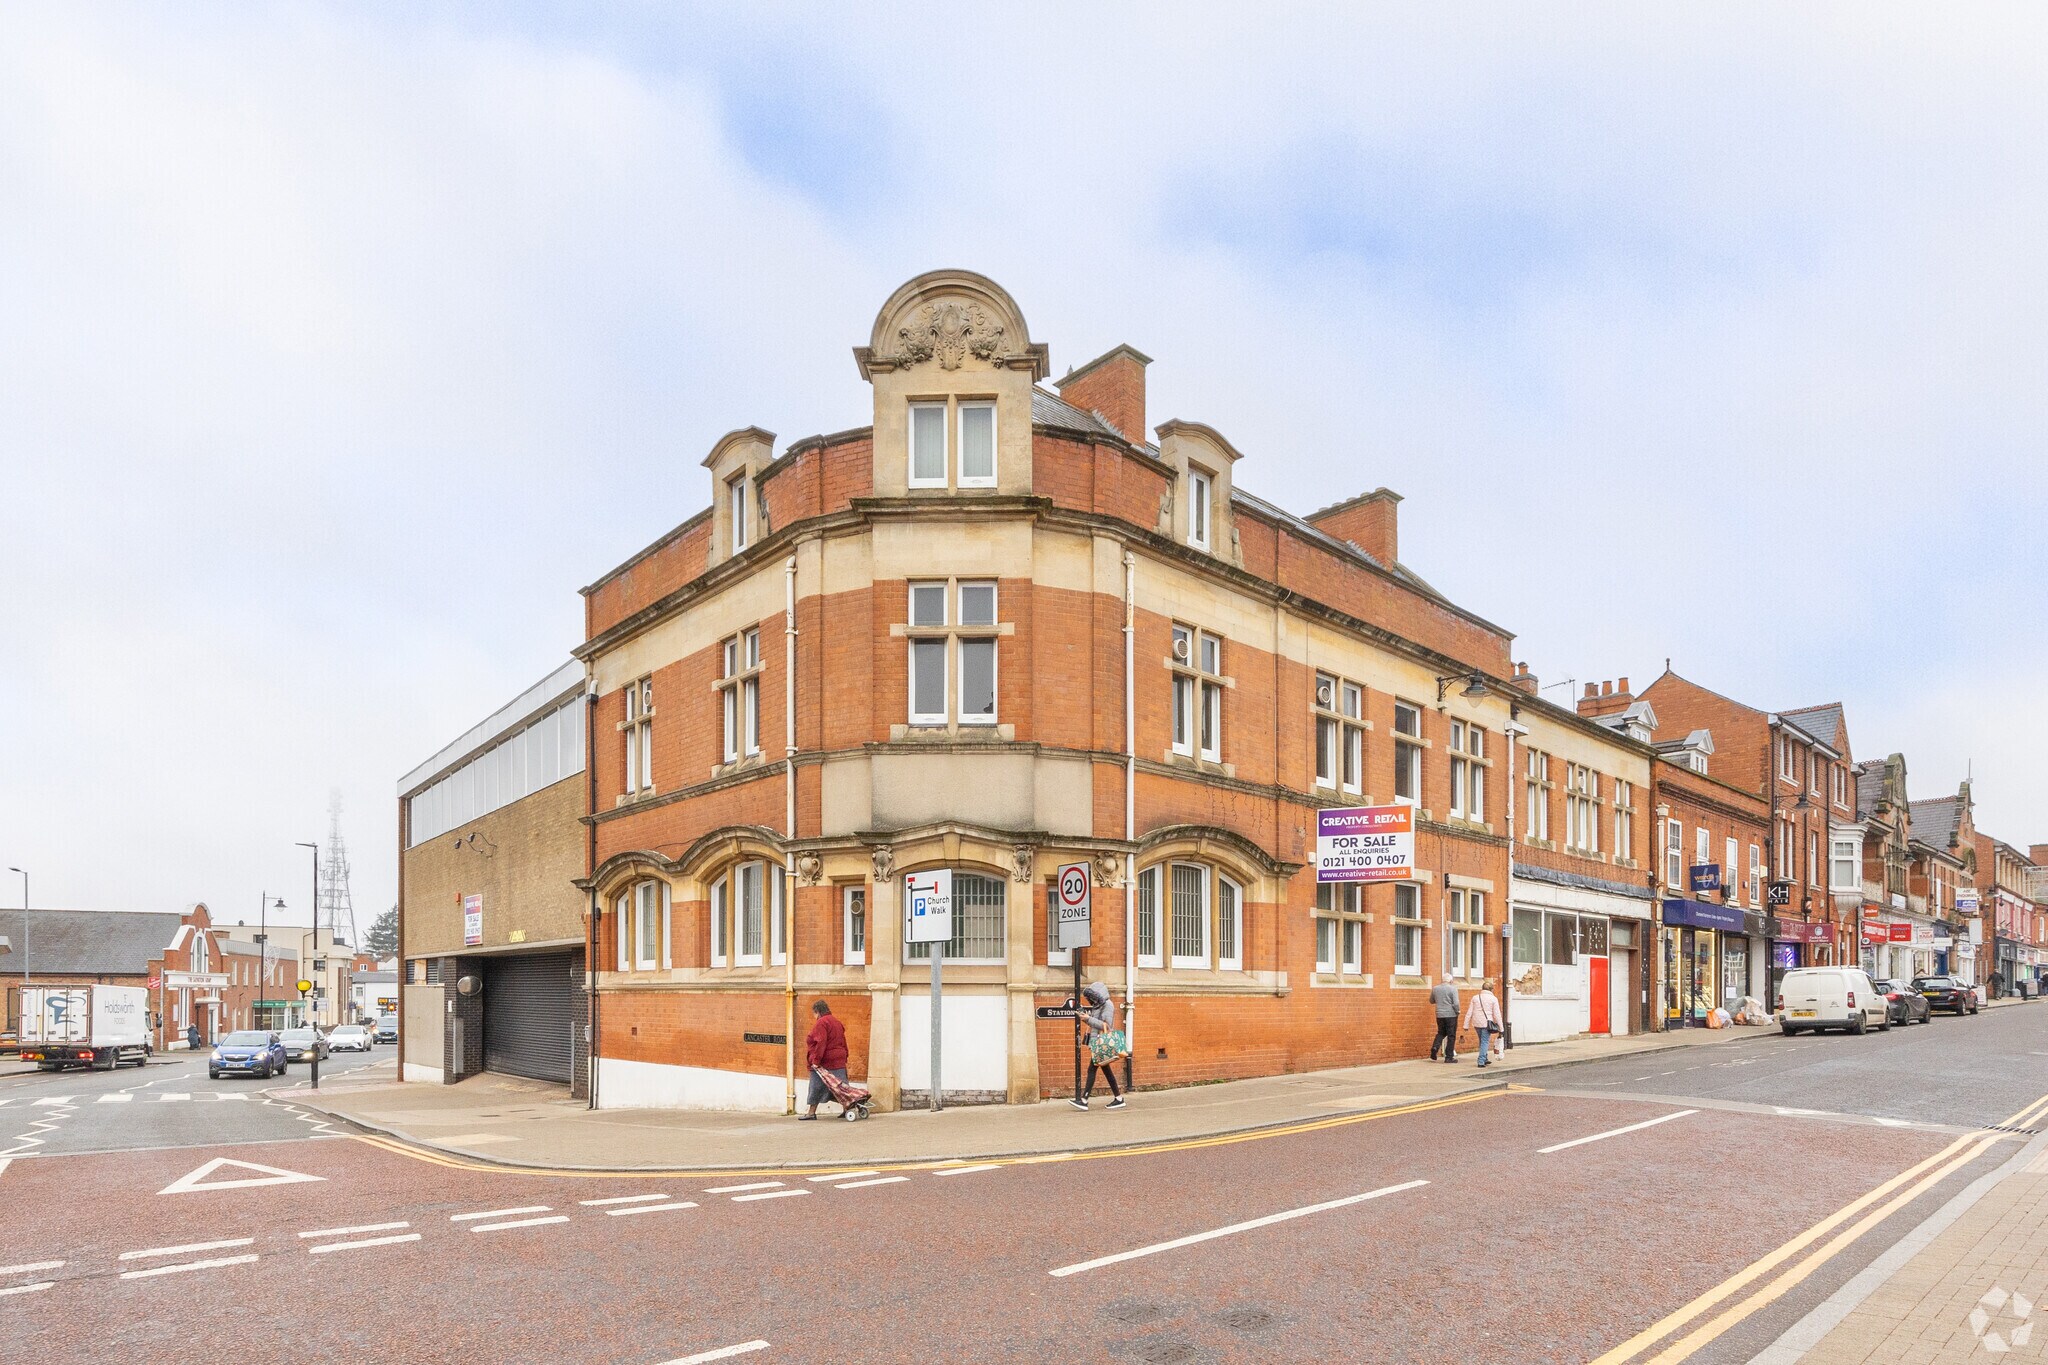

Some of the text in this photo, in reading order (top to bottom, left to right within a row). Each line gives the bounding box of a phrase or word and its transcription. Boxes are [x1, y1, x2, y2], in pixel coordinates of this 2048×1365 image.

[1322, 814, 1407, 827] CREATIVE RETAIL
[1332, 835, 1396, 848] FOR SALE
[1353, 847, 1389, 855] ENQUIRIES
[1323, 855, 1406, 867] 0121 400 0407
[1322, 869, 1407, 878] www.creative-retail.co.uk
[1064, 877, 1083, 895] 20
[1768, 886, 1789, 898] KH
[927, 895, 950, 905] Church
[916, 900, 924, 915] P
[931, 906, 946, 915] Walk
[1061, 907, 1087, 919] ZONE
[104, 1001, 135, 1013] Holdsworth
[745, 1034, 770, 1042] LANCASTER
